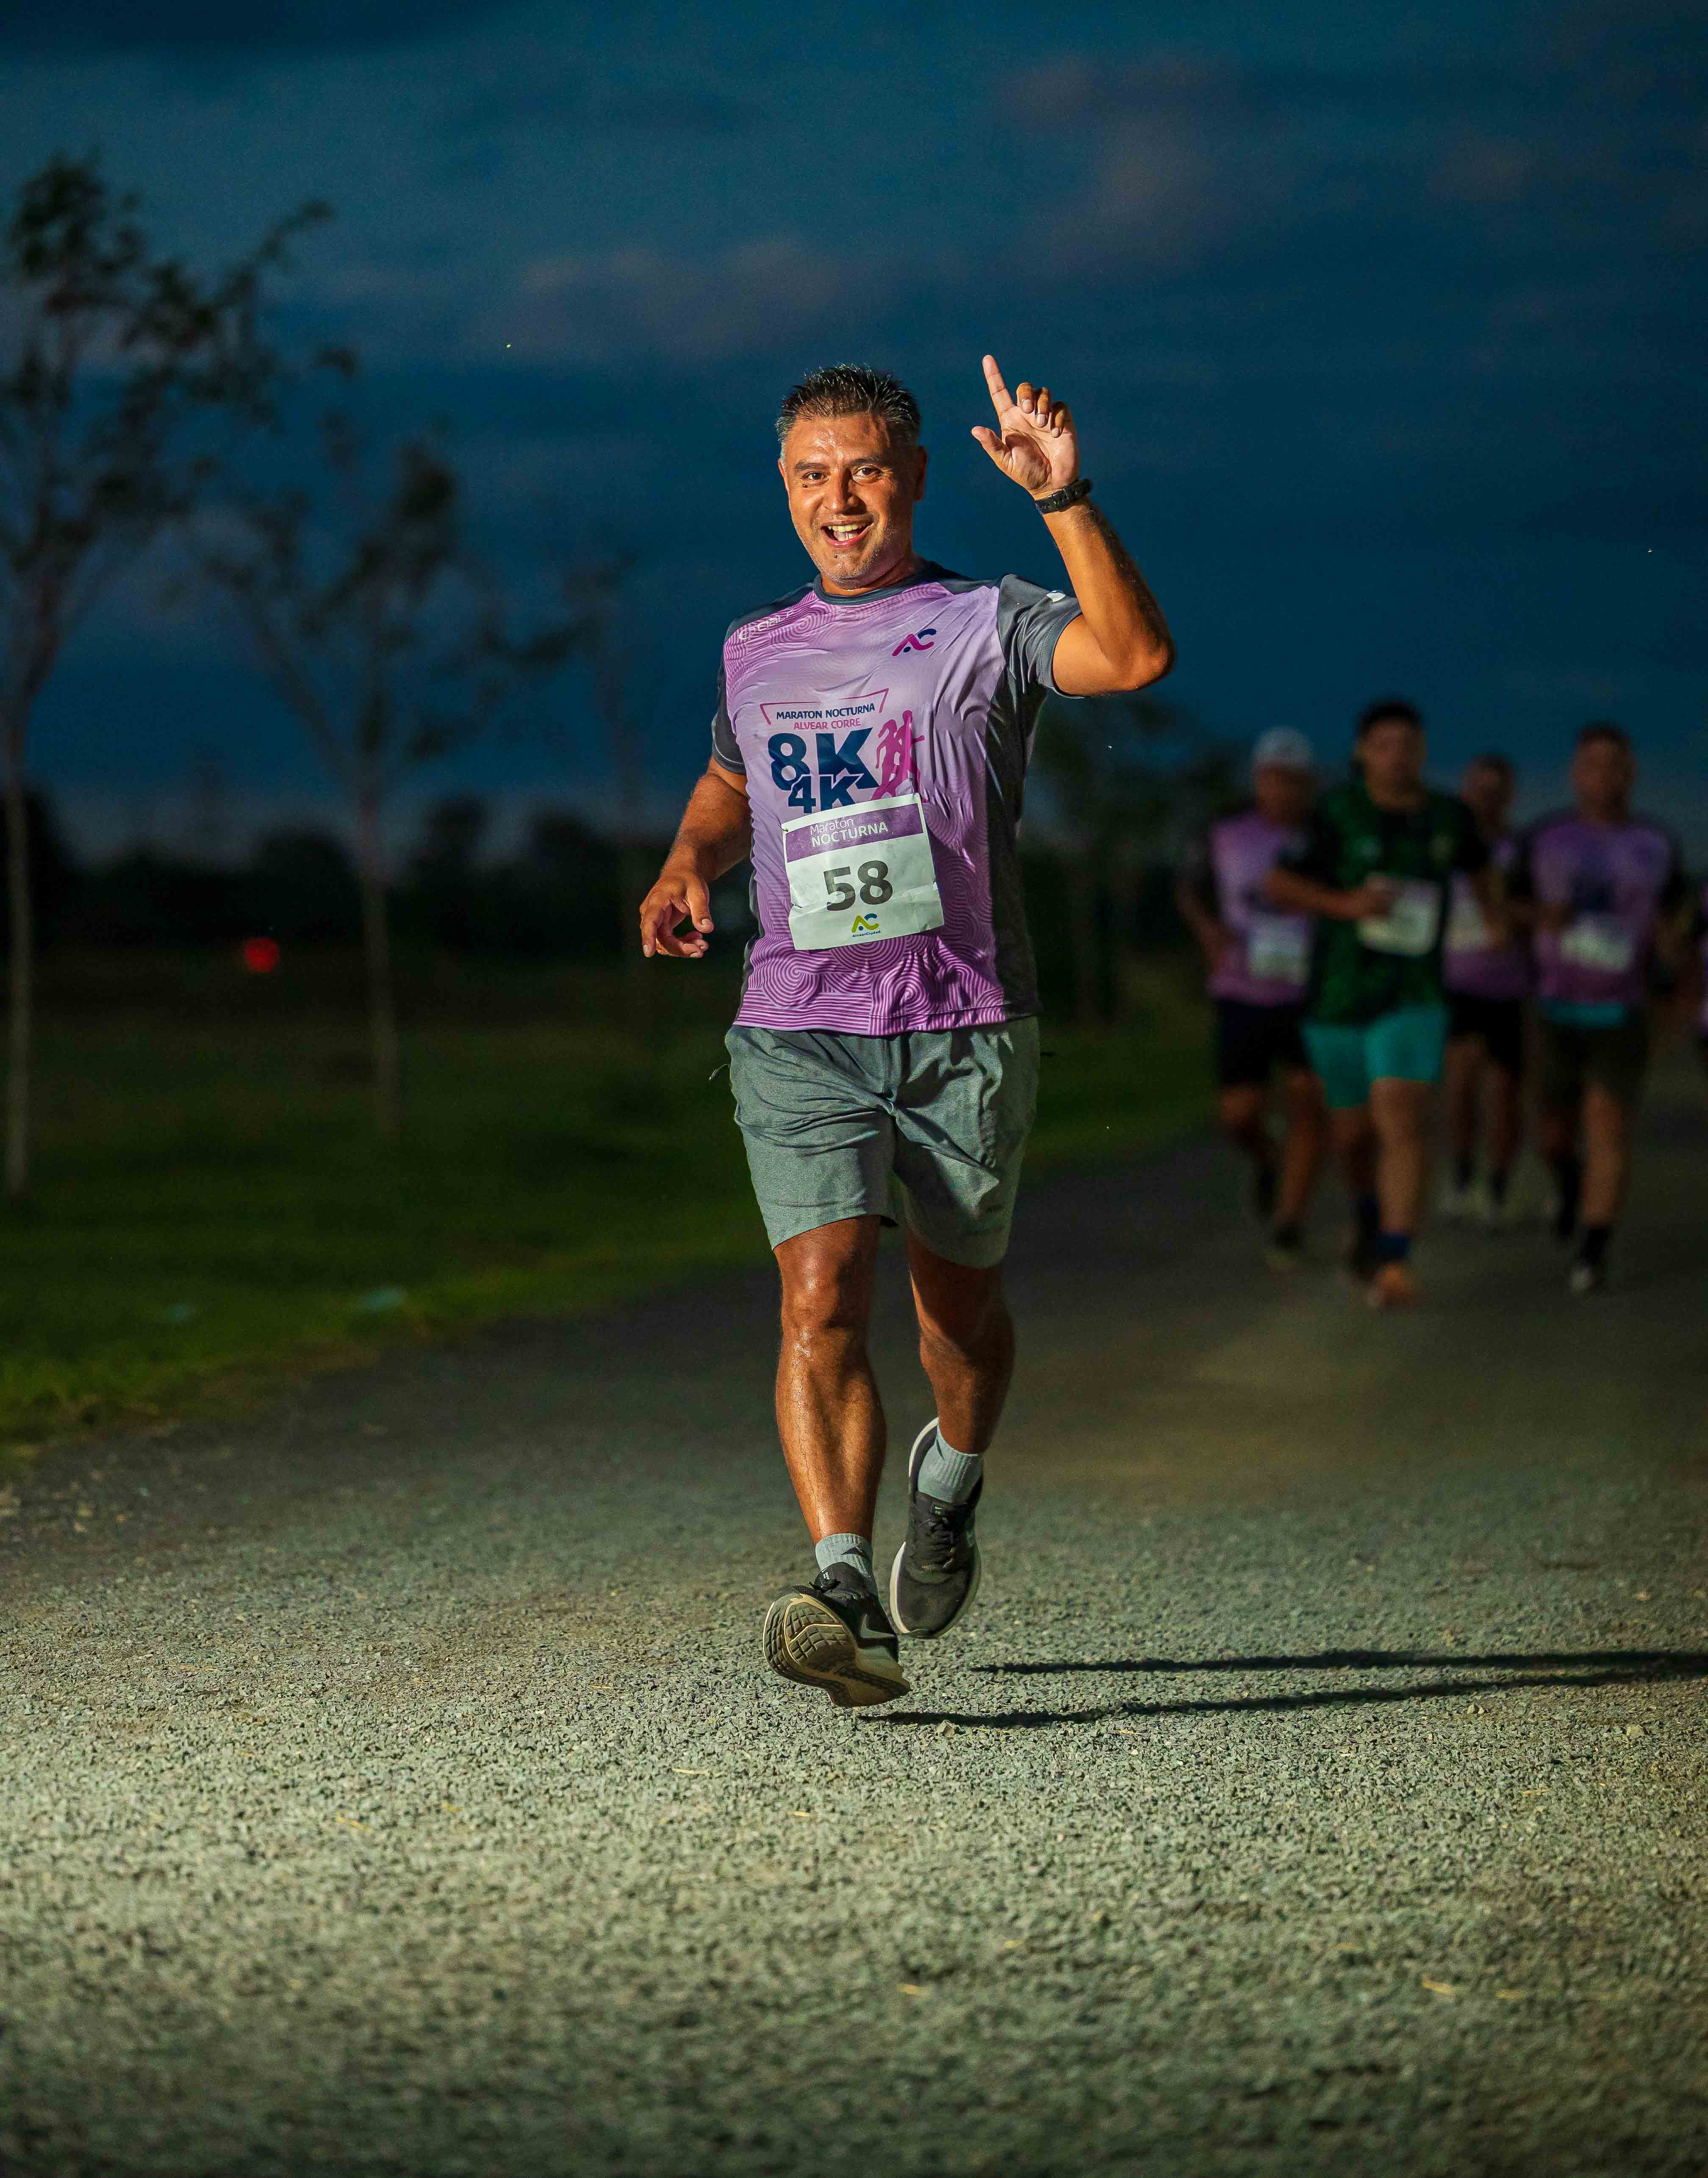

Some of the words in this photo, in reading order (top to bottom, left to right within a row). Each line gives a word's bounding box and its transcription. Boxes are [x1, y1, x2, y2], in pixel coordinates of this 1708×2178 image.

[776, 710, 822, 720] MARATON
[826, 703, 875, 718] NOCTURNA
[793, 721, 828, 730] ALVEAR
[831, 718, 861, 729] CORRE
[768, 727, 880, 791] 8K
[788, 776, 863, 814] 4K
[810, 817, 854, 835] Maratón
[811, 821, 888, 848] NOCTURNA
[823, 860, 893, 911] 58
